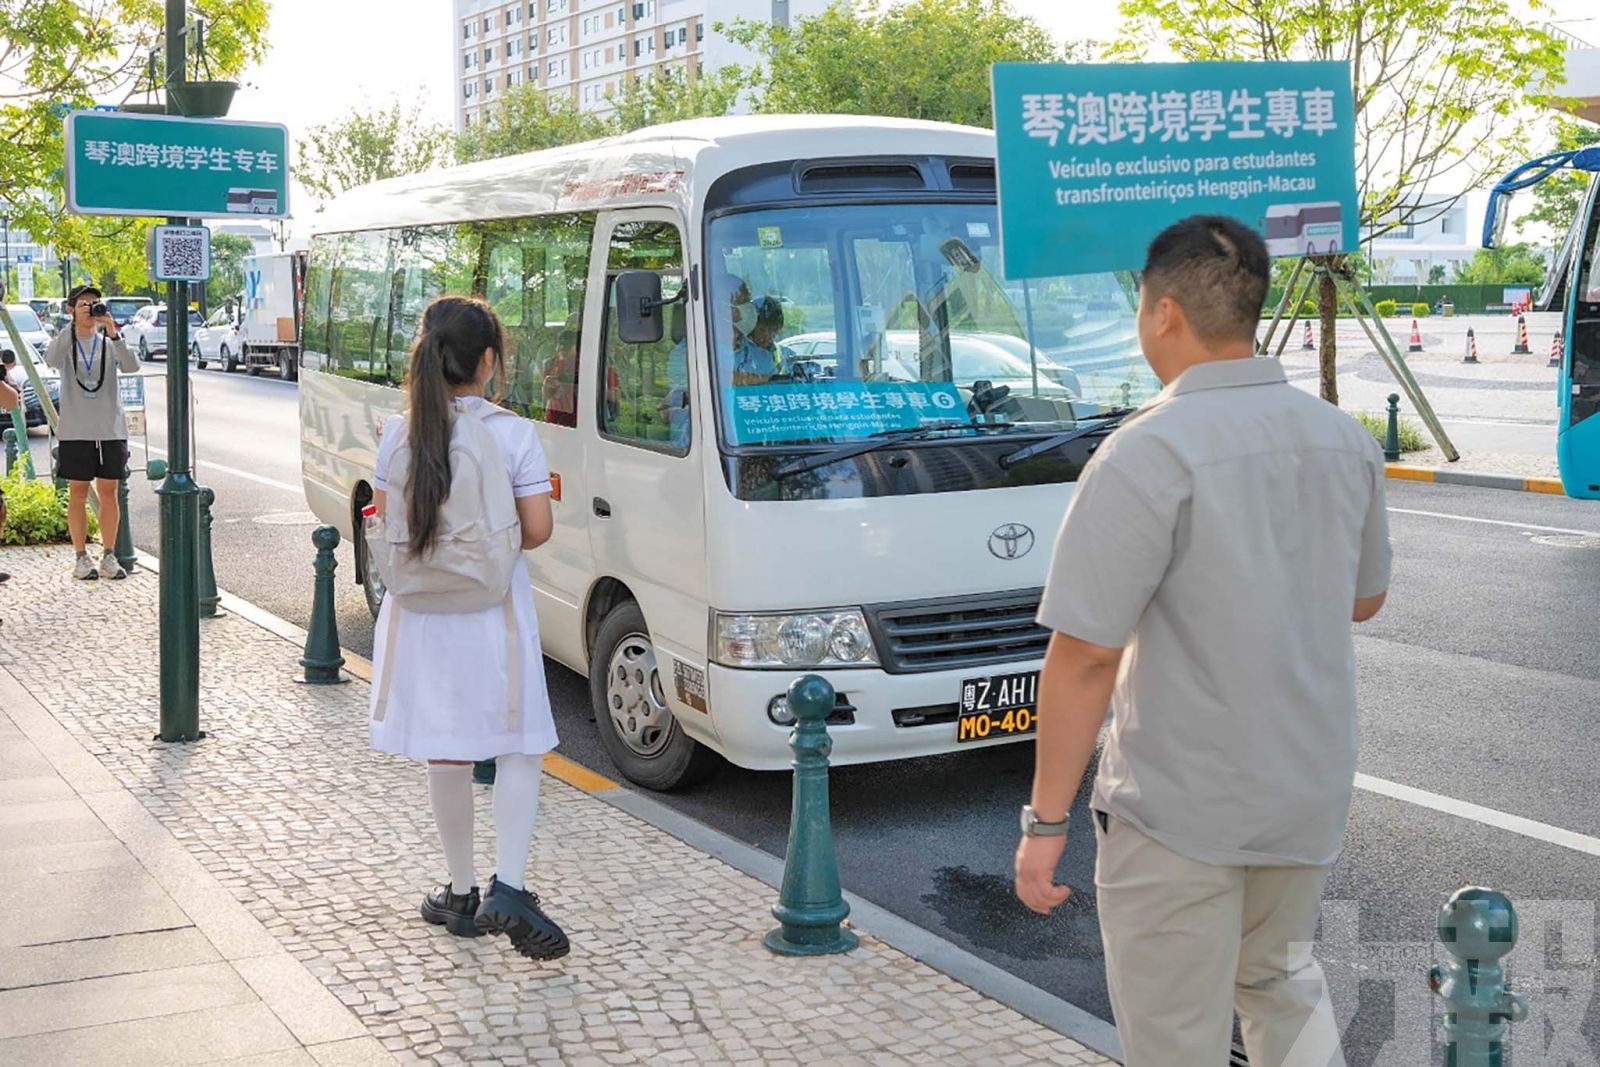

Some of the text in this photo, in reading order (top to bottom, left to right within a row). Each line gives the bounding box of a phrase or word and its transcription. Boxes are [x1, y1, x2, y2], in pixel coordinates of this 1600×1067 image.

[1021, 86, 1338, 147] 琴澳跨境學生專車
[84, 140, 279, 173] 琴澳跨境学生专车
[1049, 150, 1316, 178] Veículo exclusivo para estudantes
[1056, 175, 1316, 205] transfronteiriços Hengqin-Macau
[738, 391, 930, 412] 琴澳跨境學生專車
